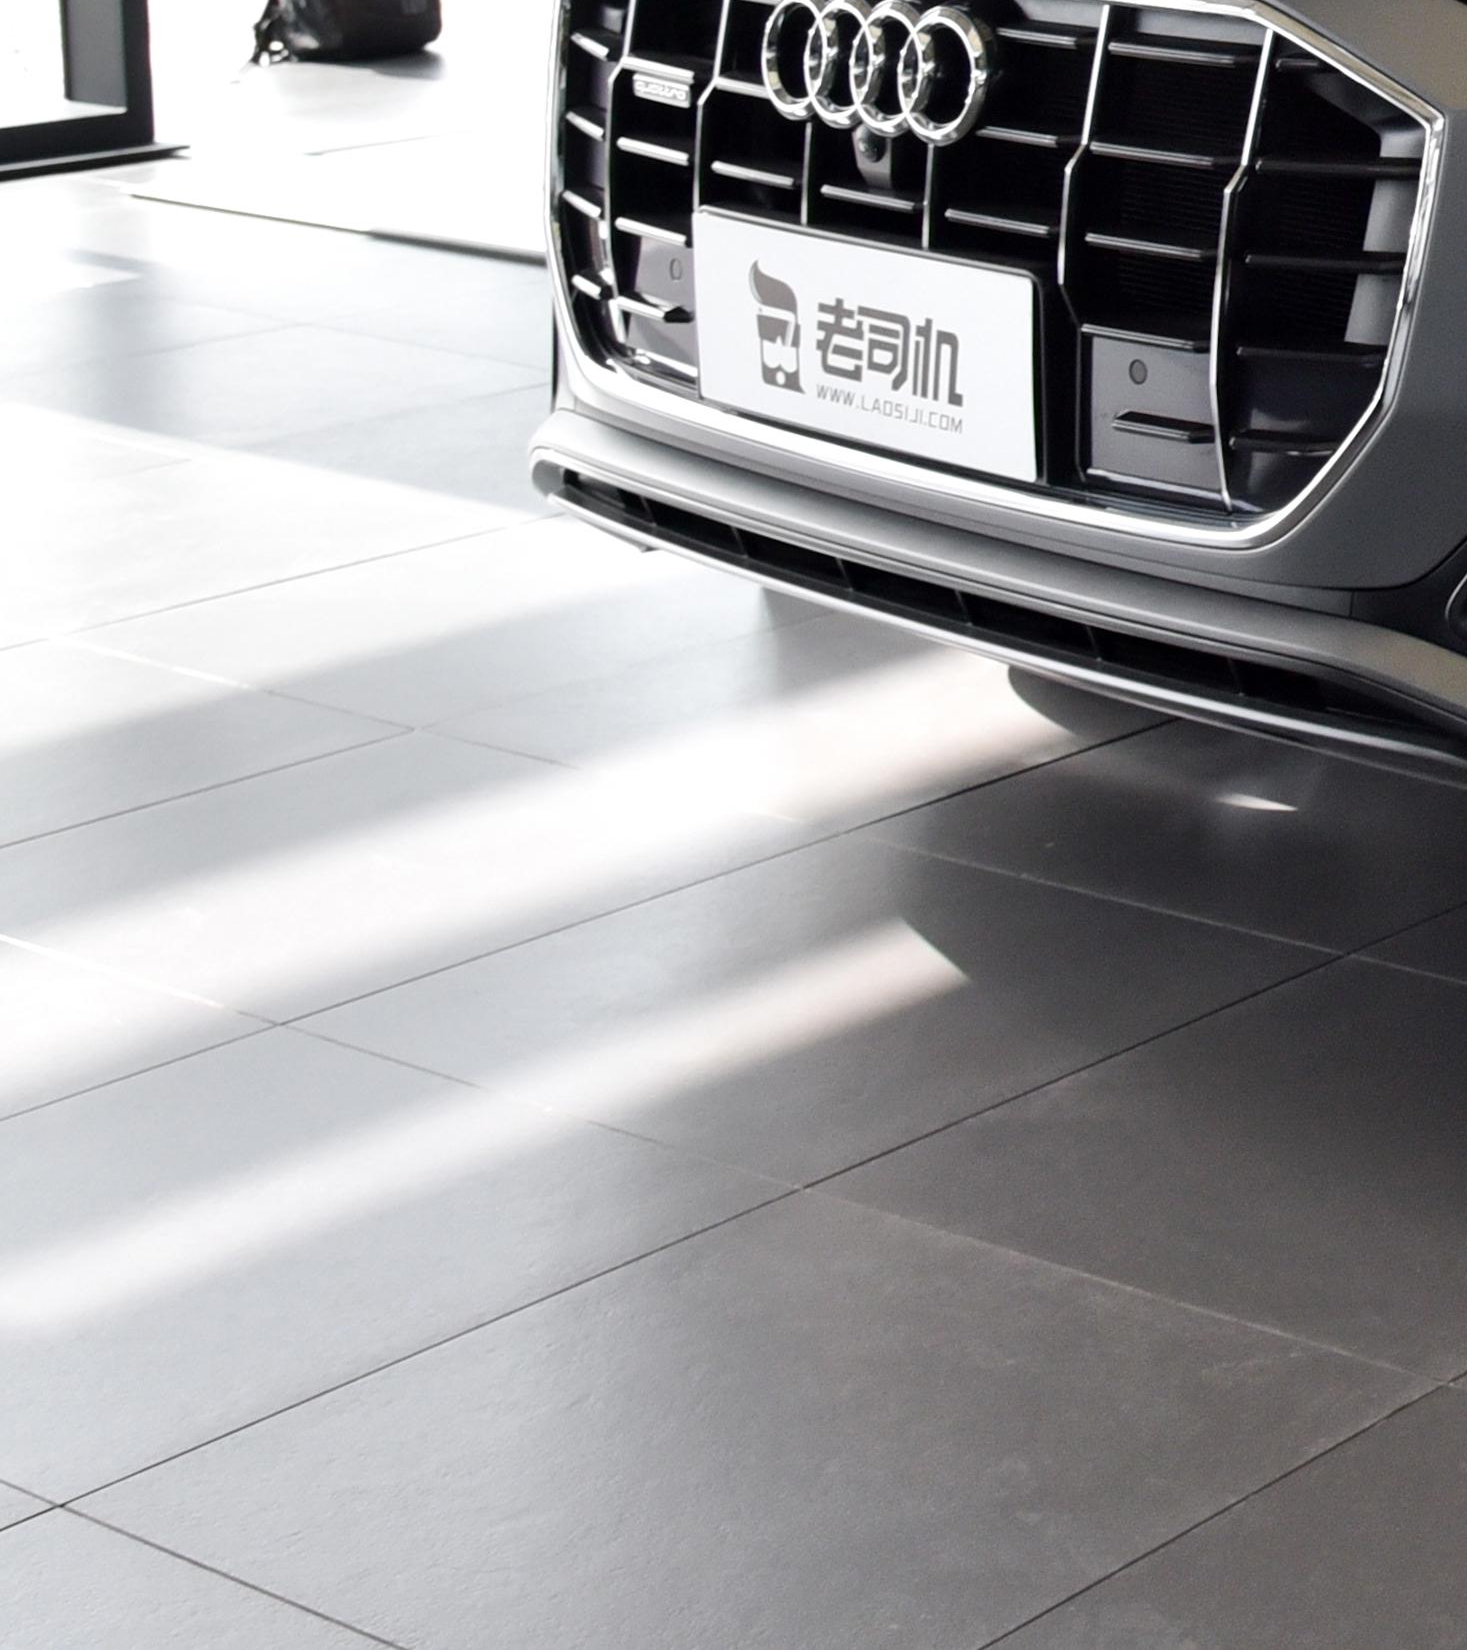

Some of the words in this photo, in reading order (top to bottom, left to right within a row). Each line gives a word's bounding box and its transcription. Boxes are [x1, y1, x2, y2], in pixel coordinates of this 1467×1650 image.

[816, 297, 963, 407] 老司机
[816, 384, 963, 434] WWW.LAOSIJI.COM
